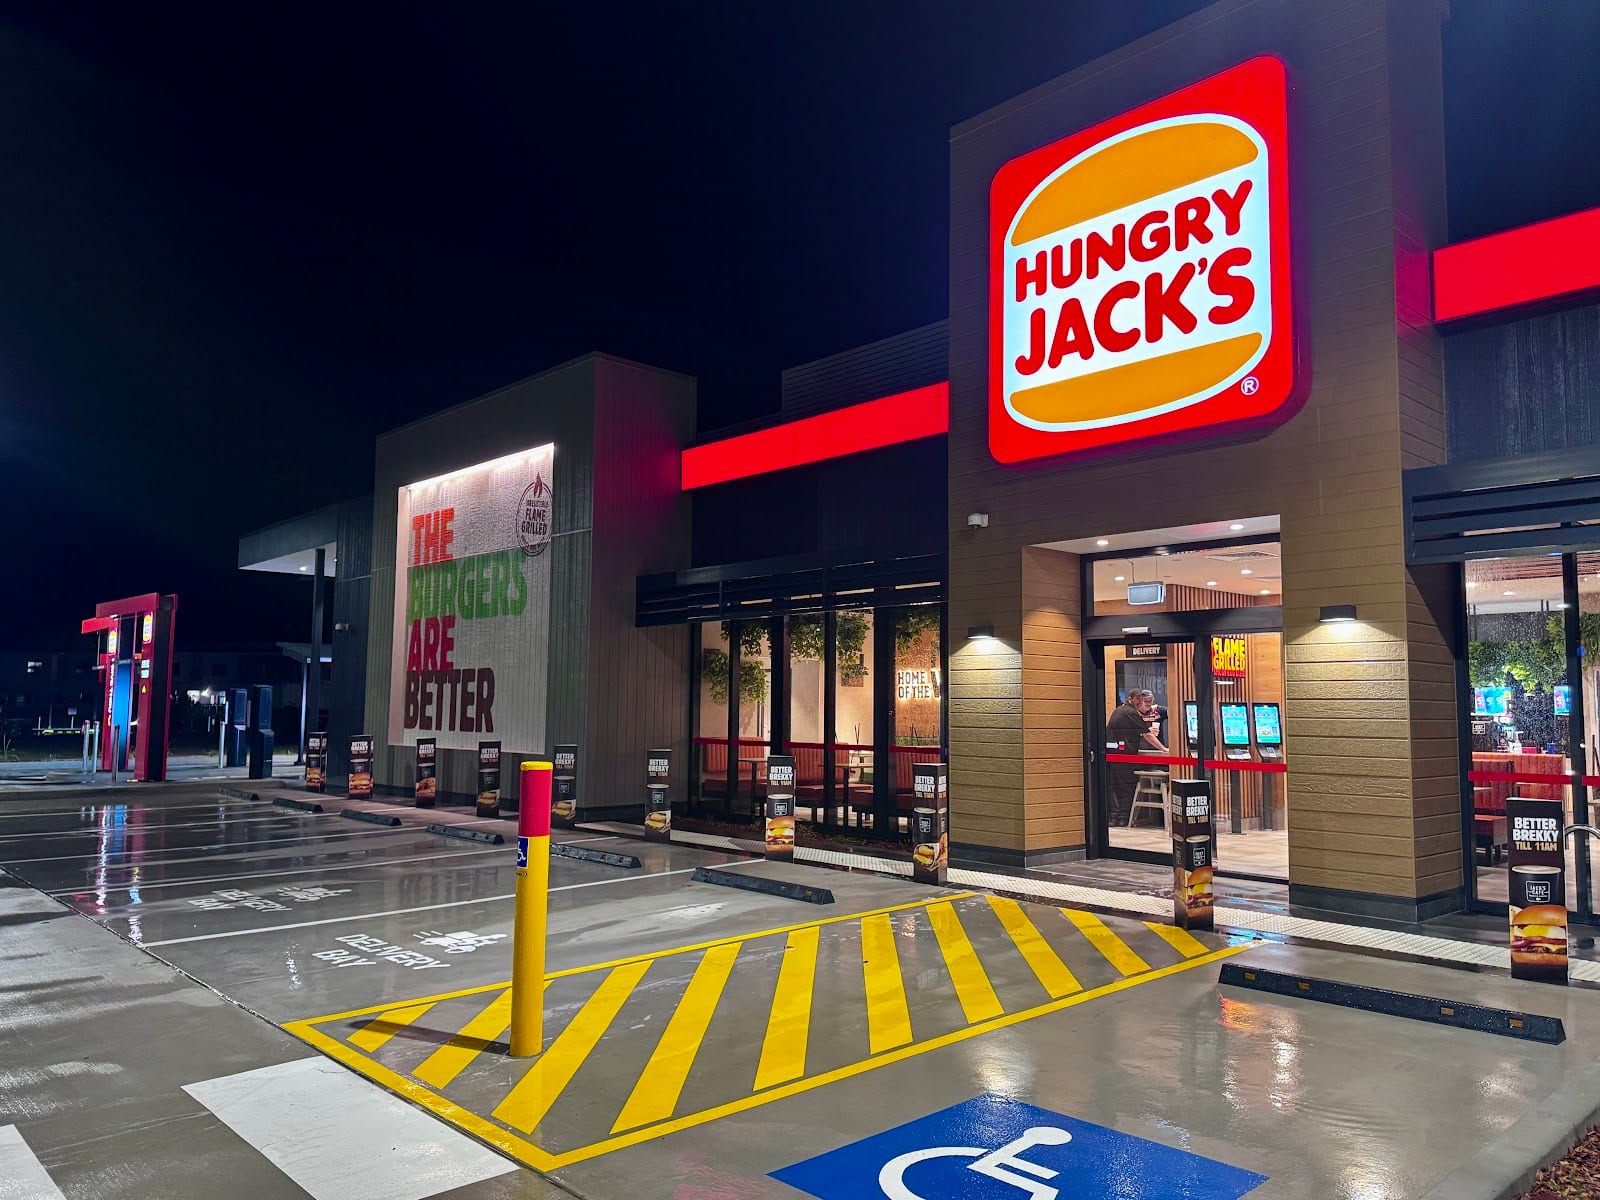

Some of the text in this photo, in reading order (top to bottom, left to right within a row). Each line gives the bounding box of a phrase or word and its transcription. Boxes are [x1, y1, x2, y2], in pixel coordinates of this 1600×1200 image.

[1015, 179, 1253, 302] HUNGRY
[1015, 247, 1256, 375] JACK'S
[526, 508, 546, 522] FLAME
[412, 507, 454, 565] THE
[522, 521, 547, 536] GRILLED
[408, 550, 527, 625] BURGERS
[407, 616, 456, 671] ARE
[1132, 646, 1160, 656] DELIVERY
[1212, 637, 1246, 656] FLAME
[1214, 656, 1246, 671] GRILLED
[898, 671, 926, 684] HOME
[898, 686, 930, 698] OF THE
[404, 668, 495, 732] BETTER
[1186, 796, 1208, 806] BETTER
[1186, 806, 1208, 816] BREKKY
[1514, 817, 1557, 830] BETTER
[1512, 829, 1559, 842] BREKKY
[1515, 842, 1558, 851] TILL 11AM
[188, 898, 235, 910] BAY
[212, 888, 292, 912] DELIVERY
[312, 949, 376, 968] BAY
[335, 934, 451, 970] DELIVERY
